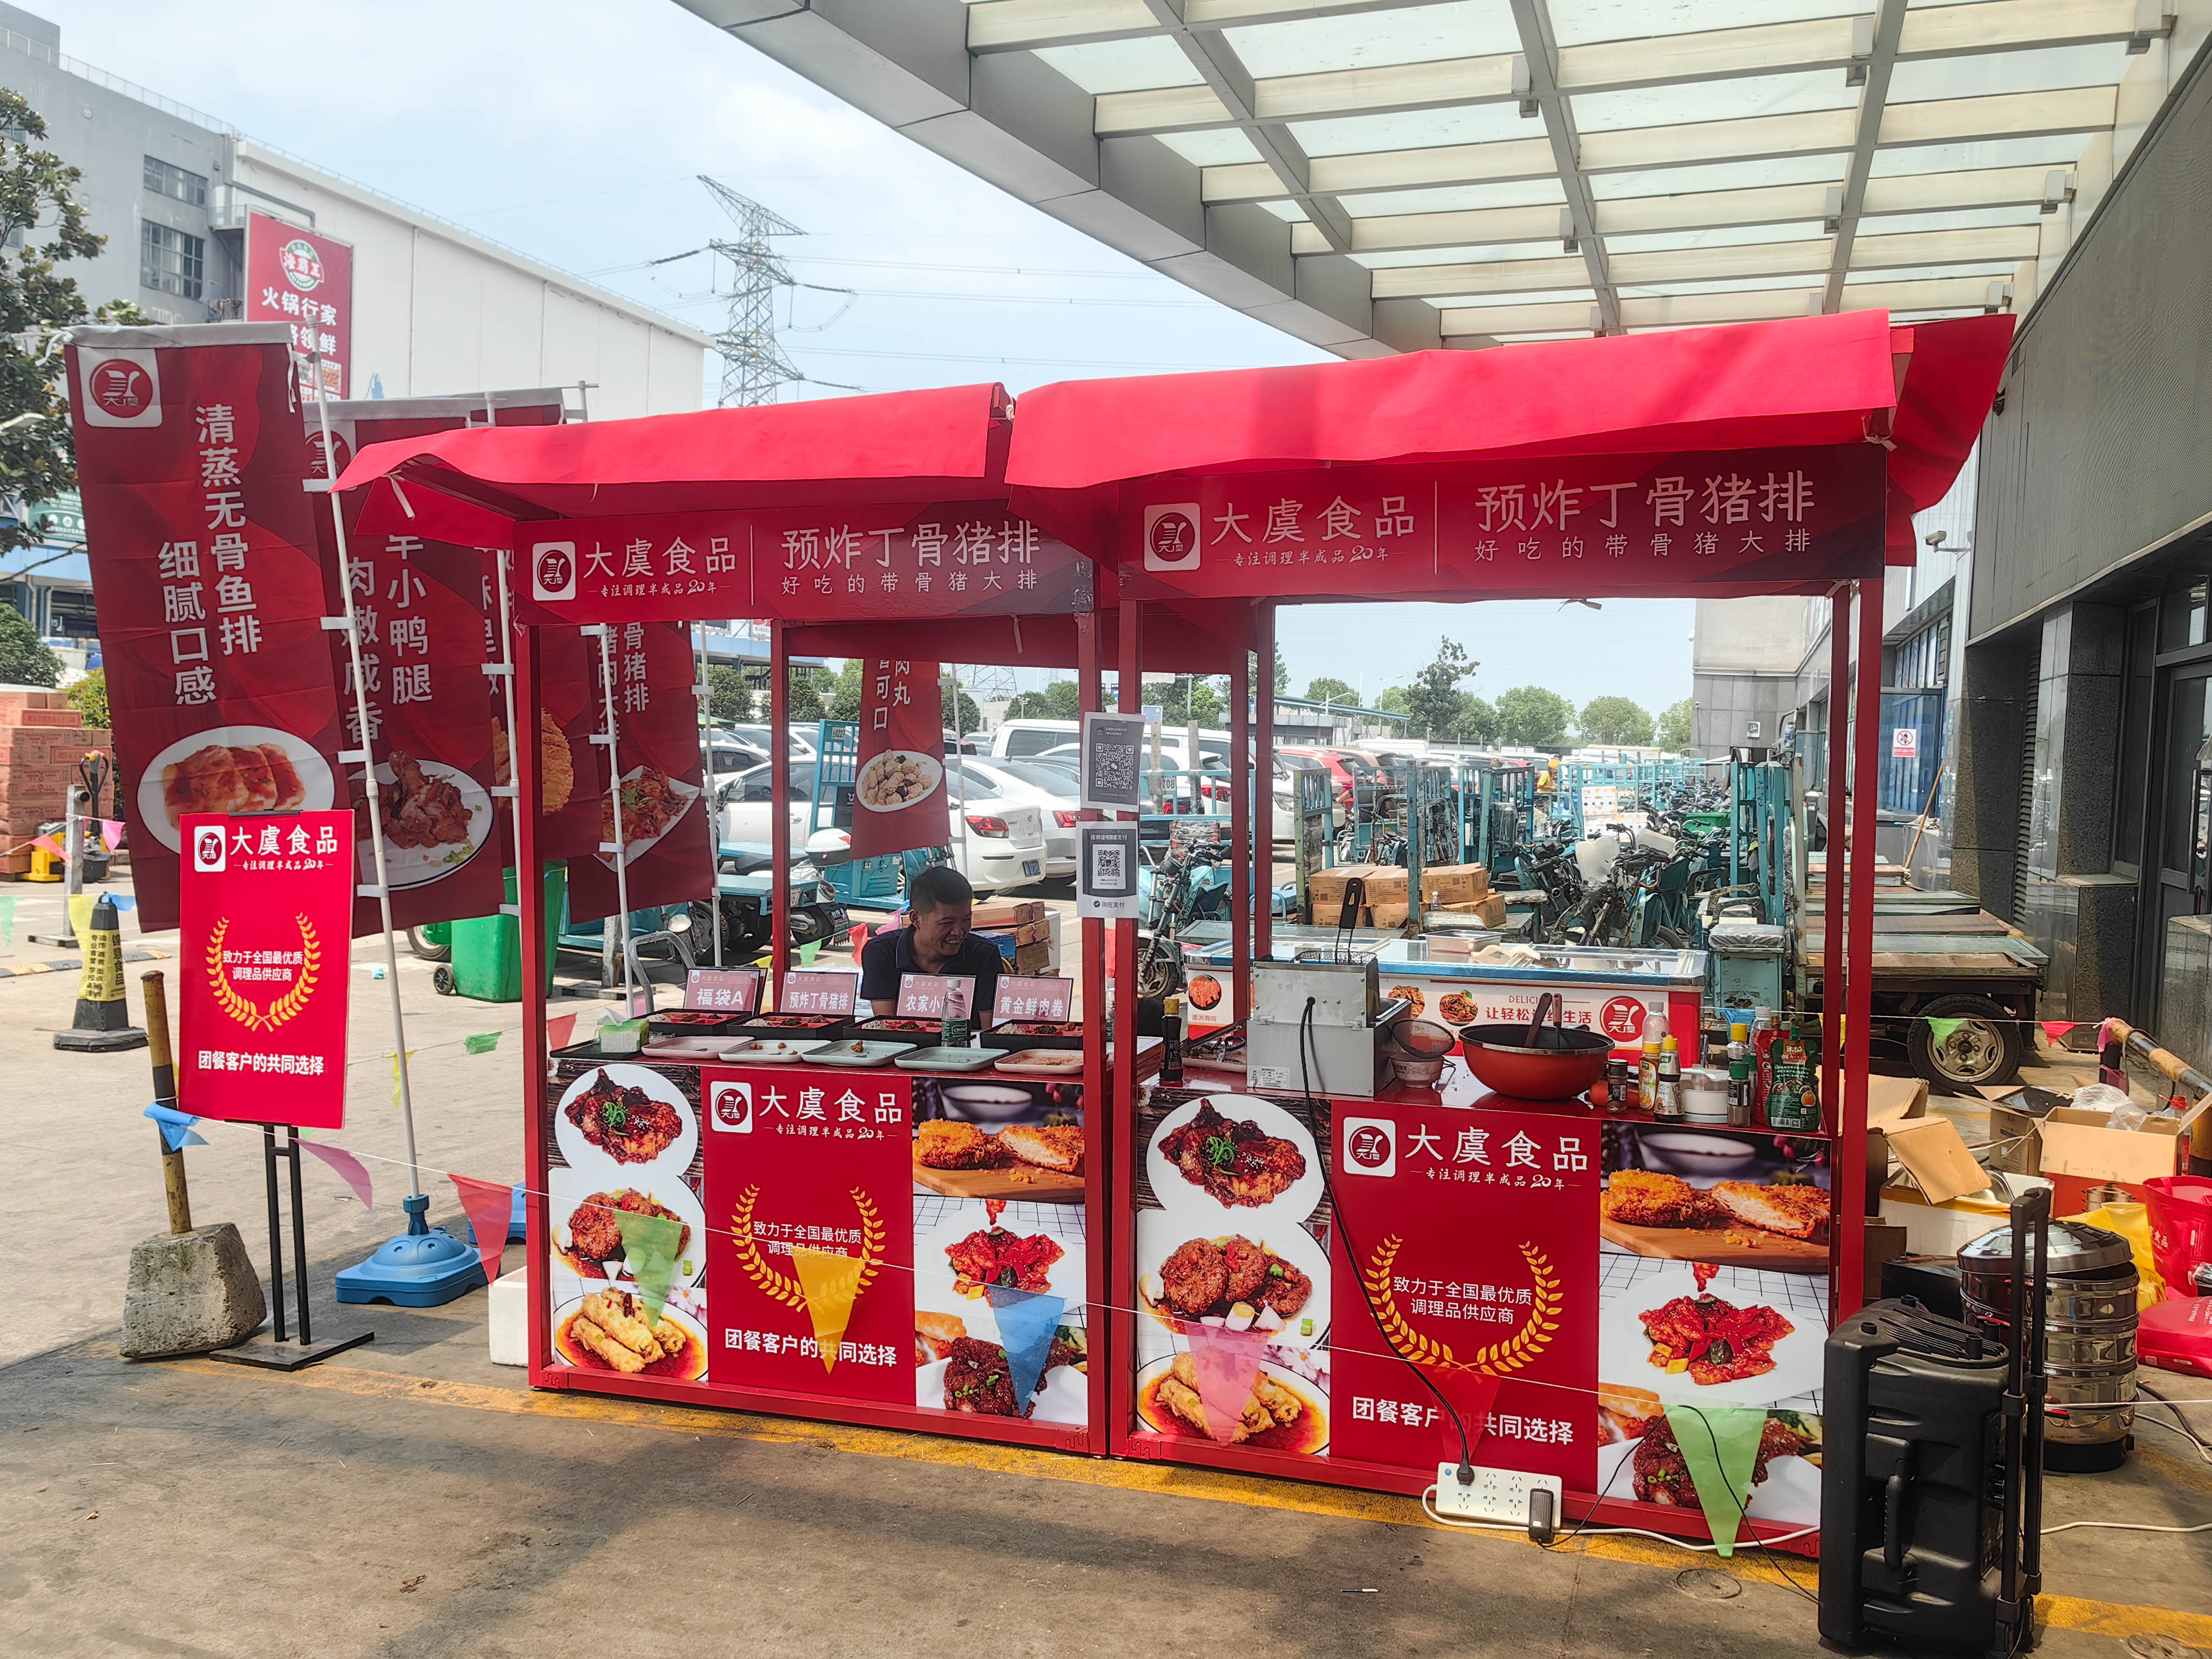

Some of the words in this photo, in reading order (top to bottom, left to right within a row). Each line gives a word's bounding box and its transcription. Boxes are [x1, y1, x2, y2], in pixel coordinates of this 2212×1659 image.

[261, 286, 337, 326] 火锅行家
[1474, 470, 1816, 534] 预炸丁骨猪排
[194, 403, 262, 657] 清蒸无骨鱼排
[1210, 495, 1414, 545] 大虞食品
[583, 536, 736, 578] 大虞食品
[780, 520, 1041, 570] 预炸丁骨猪排
[1232, 545, 1389, 568] 专注调理半成品20年
[1474, 528, 1811, 562] 好吃的带骨猪大排
[599, 579, 717, 598] 专注调理半成品20年
[781, 569, 1038, 595] 好吃的带骨猪大排
[157, 541, 217, 705] 细腻口感
[624, 622, 650, 713] 骨猪排
[230, 824, 338, 856] 大虞食品
[222, 949, 304, 965] 致力于全国最优质
[232, 967, 293, 982] 调理品供应商
[697, 988, 744, 1006] 福袋A
[789, 992, 849, 1010] 预炸丁骨猪排
[906, 994, 945, 1013] 农家小
[1000, 996, 1063, 1017] 黄金鲜肉卷
[1509, 995, 1539, 1004] DELICI
[1486, 1007, 1592, 1024] 让轻松生活
[199, 1049, 325, 1076] 团餐客户的共同选择
[758, 1085, 902, 1124] 大虞食品
[775, 1123, 885, 1141] 专注调理半成品20年
[1404, 1123, 1588, 1172] 大虞食品
[1425, 1167, 1566, 1191] 专注调理半成品20年
[753, 1220, 862, 1245] 致力于全国最优质
[1393, 1276, 1533, 1306] 致力于全国最优质
[1410, 1298, 1515, 1325] 调理品供应商
[725, 1327, 898, 1367] 团餐客户的共同选择
